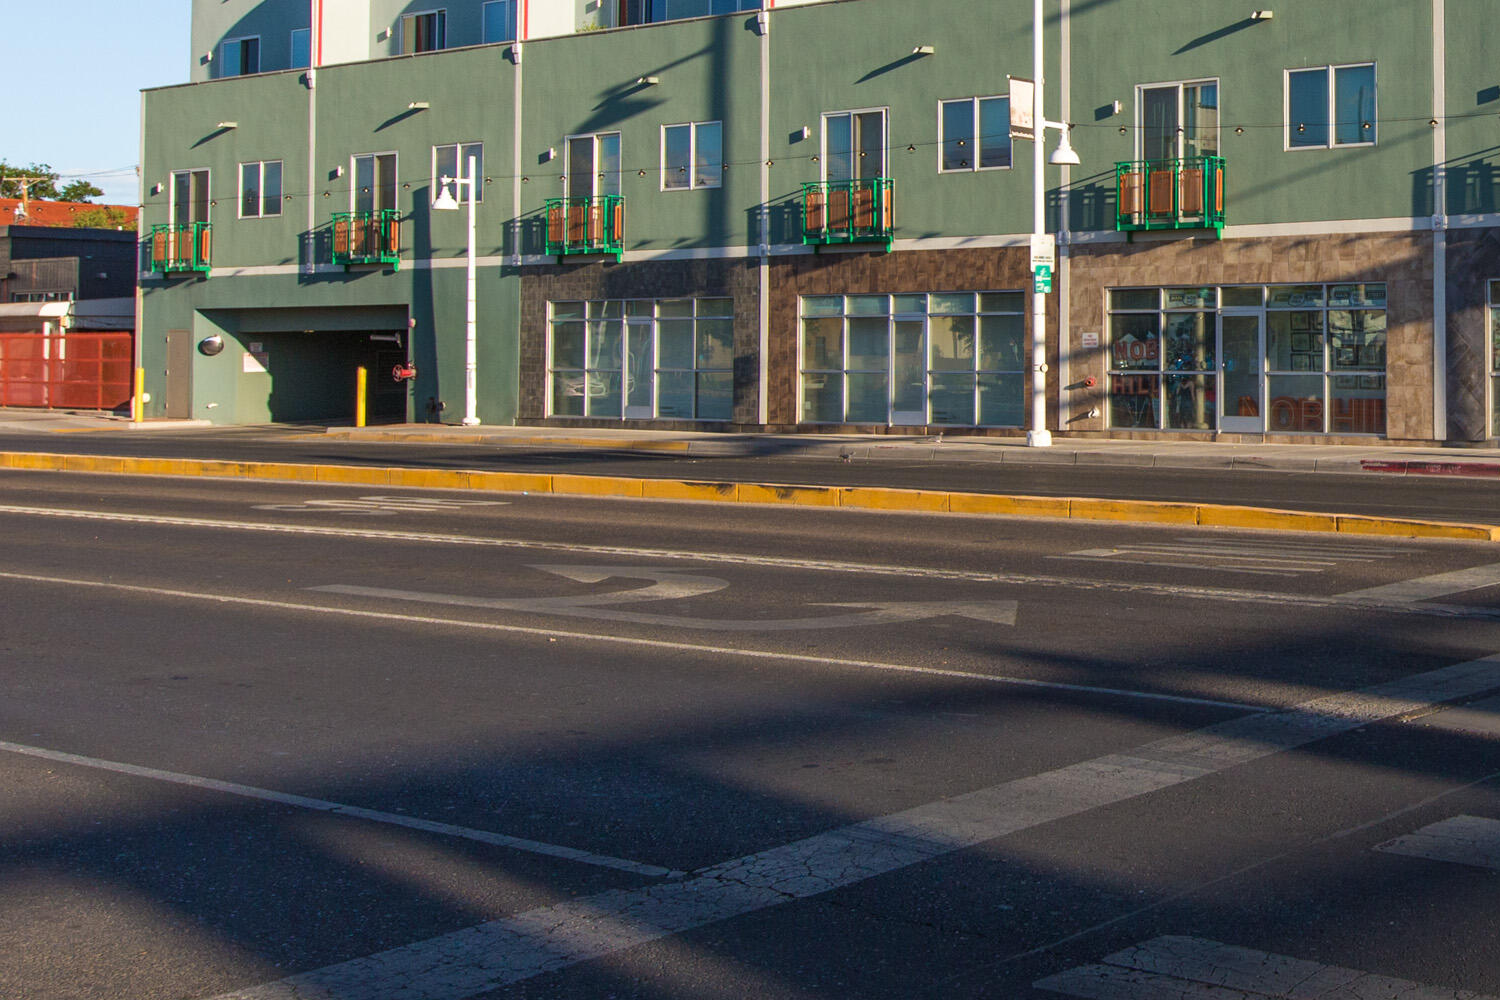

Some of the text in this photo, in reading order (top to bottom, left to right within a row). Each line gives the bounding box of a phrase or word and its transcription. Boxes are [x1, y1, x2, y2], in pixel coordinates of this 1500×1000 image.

[1114, 339, 1160, 361] NOB
[250, 495, 513, 516] BUS
[1043, 537, 1428, 577] ONLY
